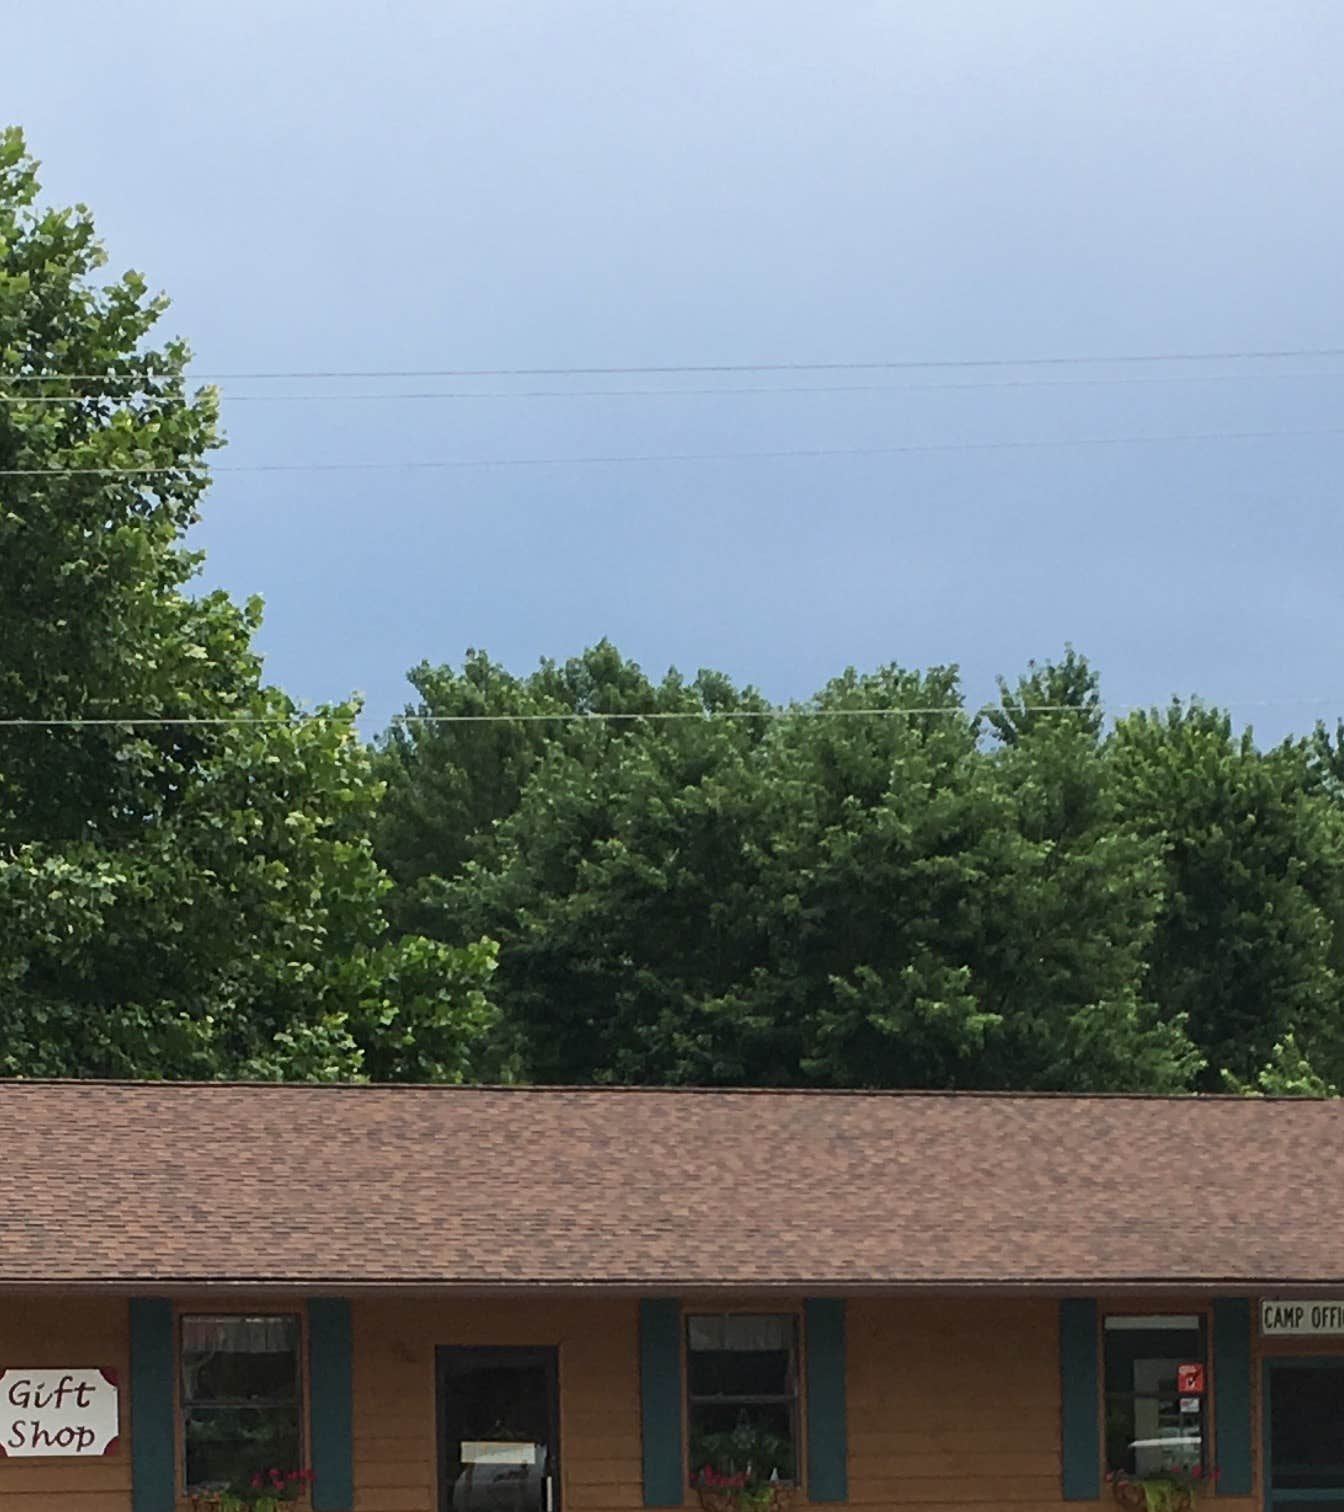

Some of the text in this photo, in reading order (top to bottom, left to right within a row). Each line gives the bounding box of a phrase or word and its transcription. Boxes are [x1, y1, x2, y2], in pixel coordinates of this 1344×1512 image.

[1264, 1306, 1304, 1329] CAMP
[8, 1375, 96, 1409] Gift
[8, 1419, 96, 1453] Shop
